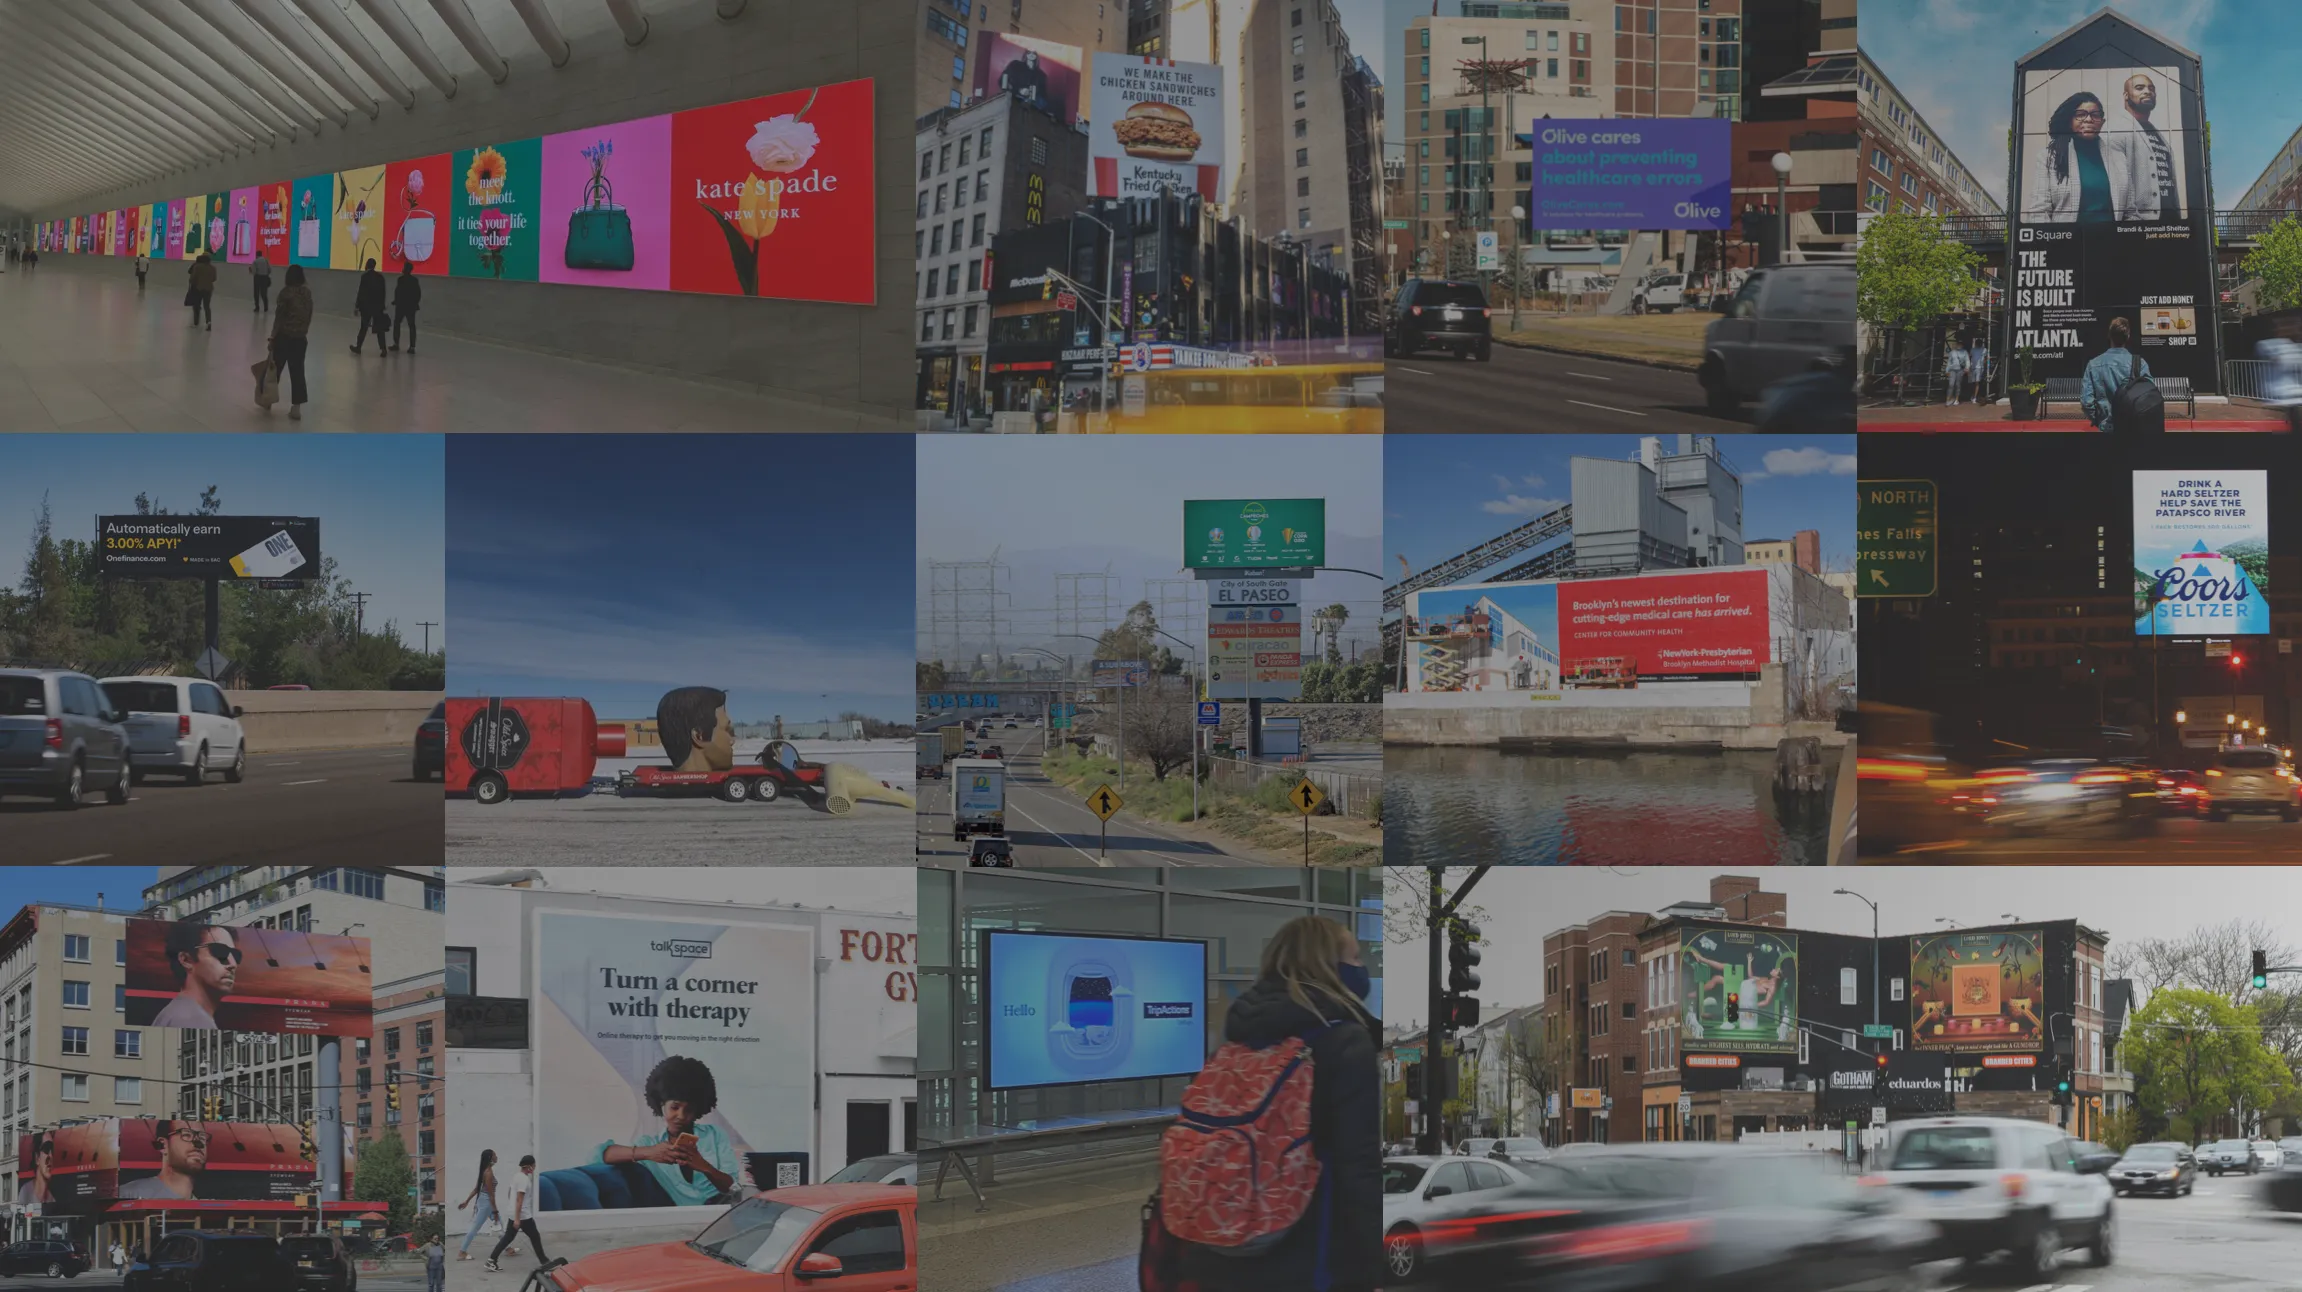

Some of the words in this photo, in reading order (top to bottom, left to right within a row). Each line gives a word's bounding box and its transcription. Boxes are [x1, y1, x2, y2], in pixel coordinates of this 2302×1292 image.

[1124, 67, 1140, 79] WE
[1144, 69, 1171, 81] MAKE
[1174, 72, 1193, 84] THE
[1100, 76, 1146, 90] CHICKEN
[1150, 82, 1216, 97] SANDWICHES
[1122, 90, 1164, 104] AROUND
[1168, 94, 1197, 107] HERE.
[1542, 129, 1587, 145] Olive
[1592, 132, 1641, 145] cares
[1542, 149, 1595, 165] about
[1600, 149, 1698, 169] preventing
[1134, 165, 1182, 182] Kentucky
[1542, 169, 1642, 186] healthcare
[1646, 172, 1703, 185] errors
[480, 176, 505, 189] meet
[696, 179, 746, 199] kate
[755, 169, 837, 202] spade
[1123, 178, 1150, 192] Fried
[468, 192, 484, 206] the
[486, 190, 515, 205] knott.
[724, 210, 754, 220] NEW
[760, 208, 800, 219] YORK
[1674, 202, 1721, 218] Olive
[458, 217, 465, 230] it
[467, 216, 483, 230] ties
[484, 219, 508, 233] your
[510, 213, 527, 229] life
[469, 231, 512, 250] together.
[2036, 230, 2072, 242] Square
[2019, 251, 2047, 268] THE
[2017, 270, 2074, 287] FUTURE
[2017, 290, 2031, 307] IS
[2034, 289, 2075, 307] BUILT
[2140, 296, 2158, 304] JUST
[2159, 296, 2171, 304] ADD
[2172, 296, 2194, 304] HONEY
[2016, 310, 2031, 327] IN
[2015, 329, 2083, 348] ATLANTA.
[2169, 337, 2187, 346] SHOP
[1871, 491, 1928, 504] NORTH
[107, 523, 190, 536] Automatically
[193, 526, 220, 535] earn
[1887, 528, 1922, 540] Falls
[107, 538, 144, 549] 3.00%
[265, 533, 293, 558] ONE
[2154, 567, 2250, 601] Coors
[1219, 590, 1235, 602] EL
[1241, 589, 1290, 602] PASEO
[1573, 599, 1619, 611] Brooklyn's
[1621, 596, 1655, 608] newest
[1658, 594, 1713, 606] destination
[1716, 593, 1731, 603] for
[1573, 613, 1631, 624] cutting-edge
[1633, 610, 1670, 621] medical
[1672, 610, 1693, 618] care
[1695, 608, 1711, 617] has
[1713, 606, 1753, 617] arrived.
[2158, 604, 2248, 617] SELTZER
[1217, 627, 1255, 635] EDWARDS
[1258, 626, 1300, 634] THEATRES
[1574, 631, 1598, 639] CENTER
[1600, 630, 1612, 638] FOR
[1613, 629, 1656, 637] COMMUNITY
[1235, 642, 1290, 651] curacao
[1663, 648, 1753, 659] NewYork-Presbyterian
[1663, 660, 1691, 669] Brooklyn
[1728, 659, 1755, 667] Hospital
[650, 940, 709, 956] talkspace
[600, 968, 658, 990] Turn
[665, 978, 679, 991] a
[685, 978, 758, 994] corner
[608, 996, 659, 1017] with
[666, 998, 751, 1028] therapy
[1004, 1005, 1036, 1017] Hello
[1147, 1006, 1190, 1016] TripActions
[619, 1033, 644, 1041] therapy
[2014, 1057, 2034, 1065] CITIES
[1834, 1071, 1872, 1085] GOTHAM
[1889, 1077, 1941, 1089] eduardos
